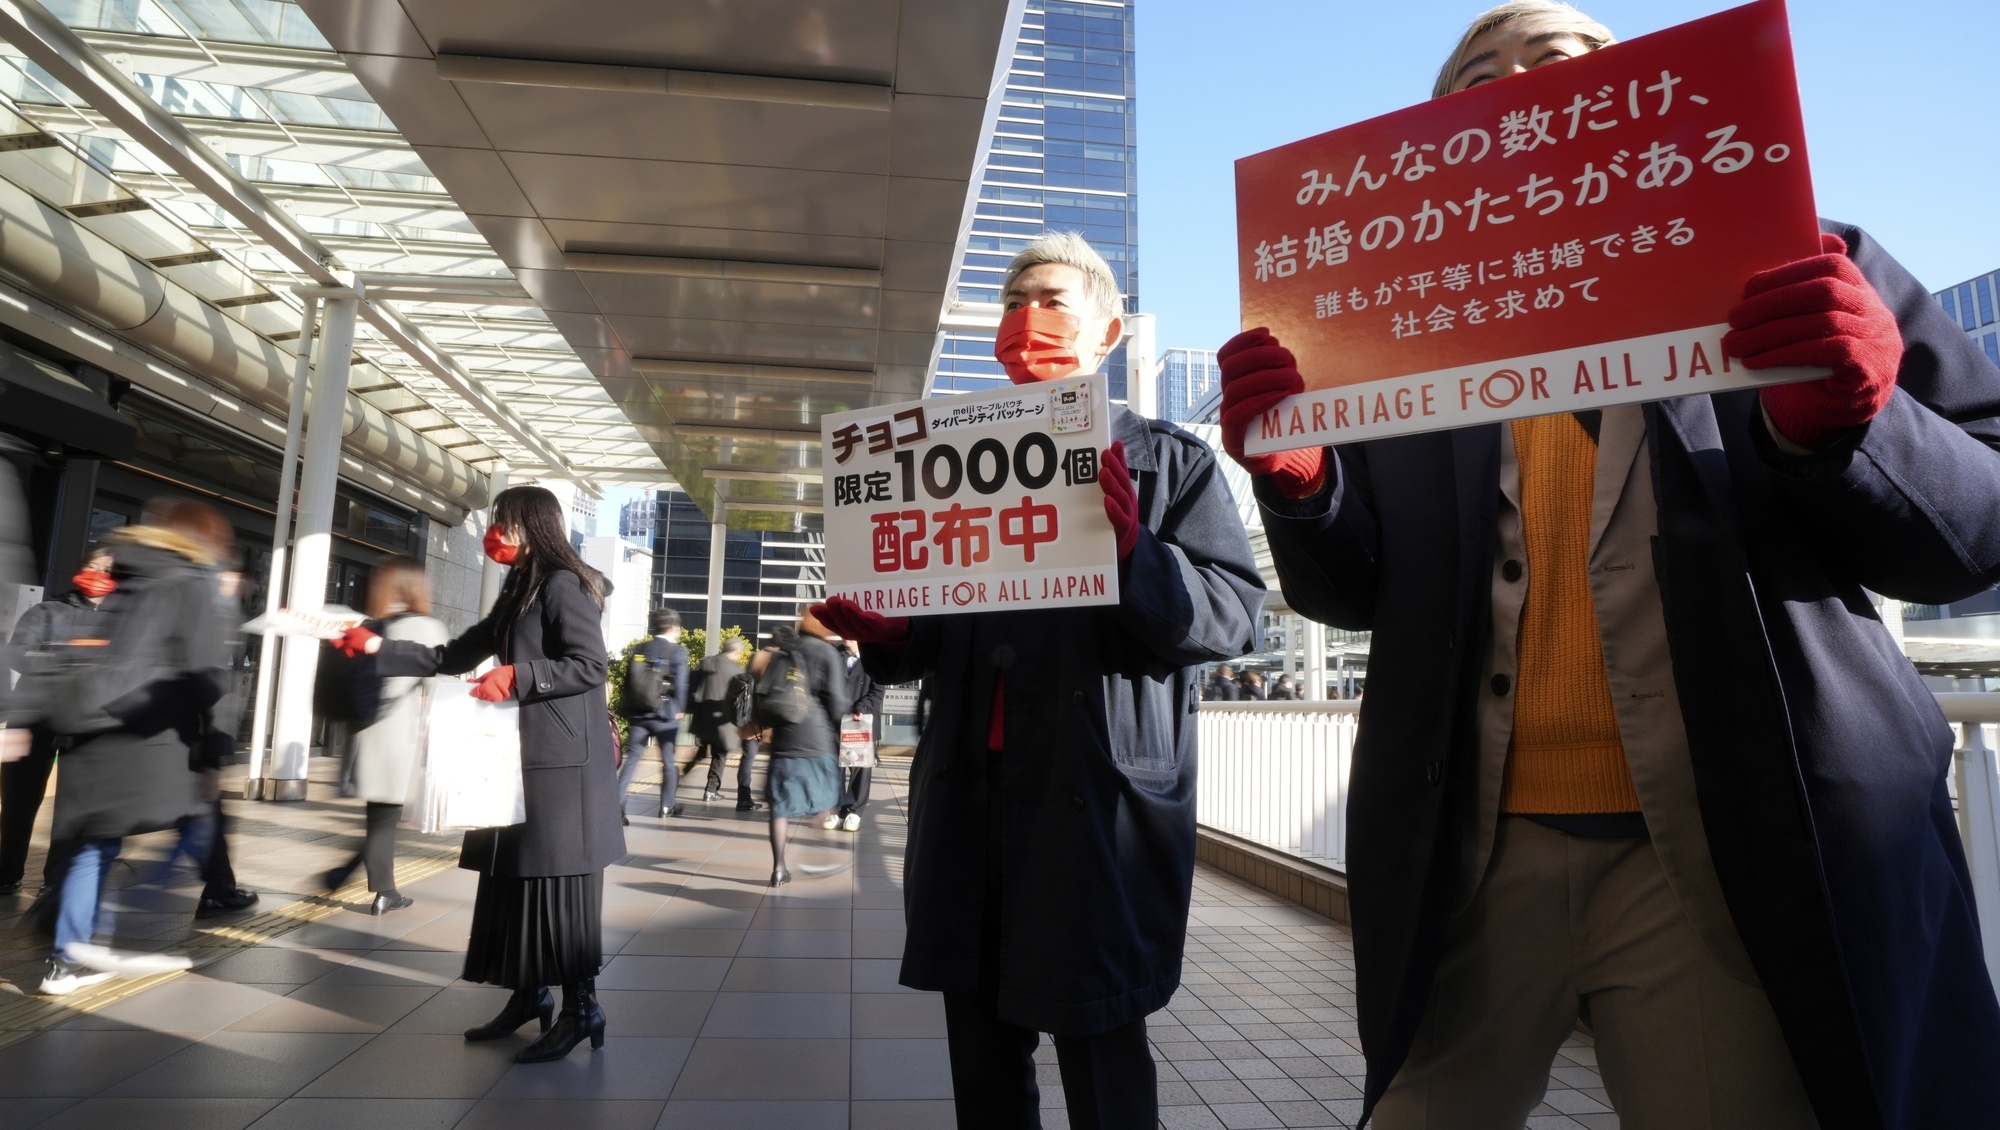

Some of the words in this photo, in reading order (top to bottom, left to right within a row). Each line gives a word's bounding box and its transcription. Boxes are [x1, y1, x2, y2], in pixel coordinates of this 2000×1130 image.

[1297, 71, 1708, 205] みんなの数だけ、
[1253, 125, 1790, 282] 結婚のかたちがある。
[1314, 217, 1694, 319] 誰もが平等に結婚できる
[1391, 277, 1600, 340] 社会を求めて
[831, 406, 927, 464] チョコ
[1261, 384, 1436, 440] MARRIAGE
[1460, 366, 1550, 410] FOR
[1573, 353, 1642, 394] ALL
[870, 495, 1059, 573] 配布中
[942, 581, 988, 606] FOR
[998, 579, 1032, 602] ALL
[1041, 573, 1106, 600] JAPAN
